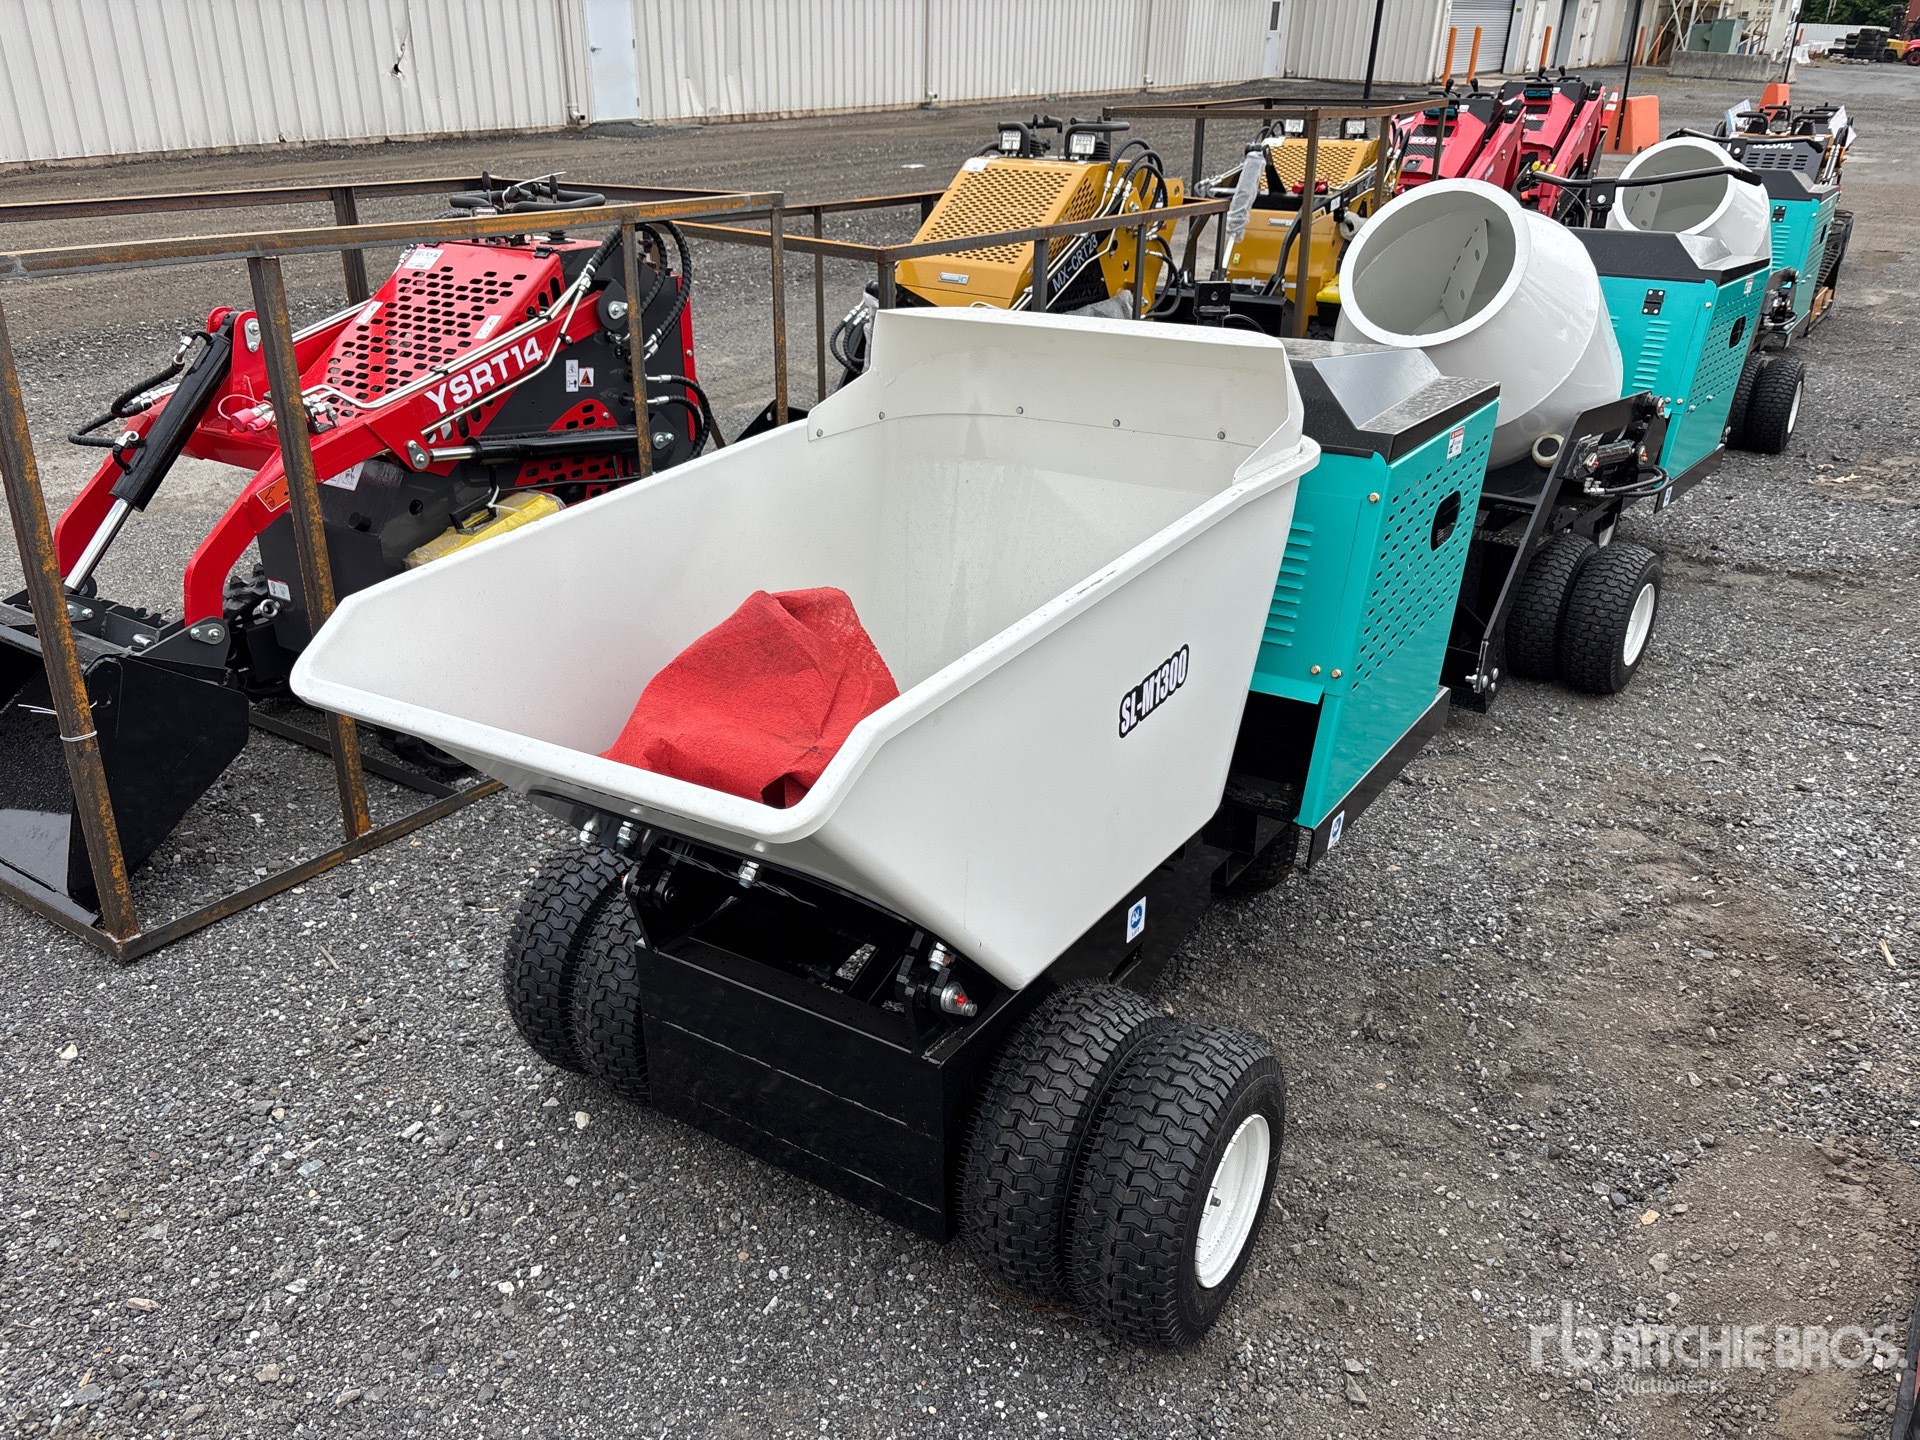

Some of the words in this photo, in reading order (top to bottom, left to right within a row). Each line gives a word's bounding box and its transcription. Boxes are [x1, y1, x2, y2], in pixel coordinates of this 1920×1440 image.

[1052, 233, 1098, 292] MX-CRT23
[424, 336, 543, 414] YSRT14
[1121, 648, 1187, 733] SL-M1300
